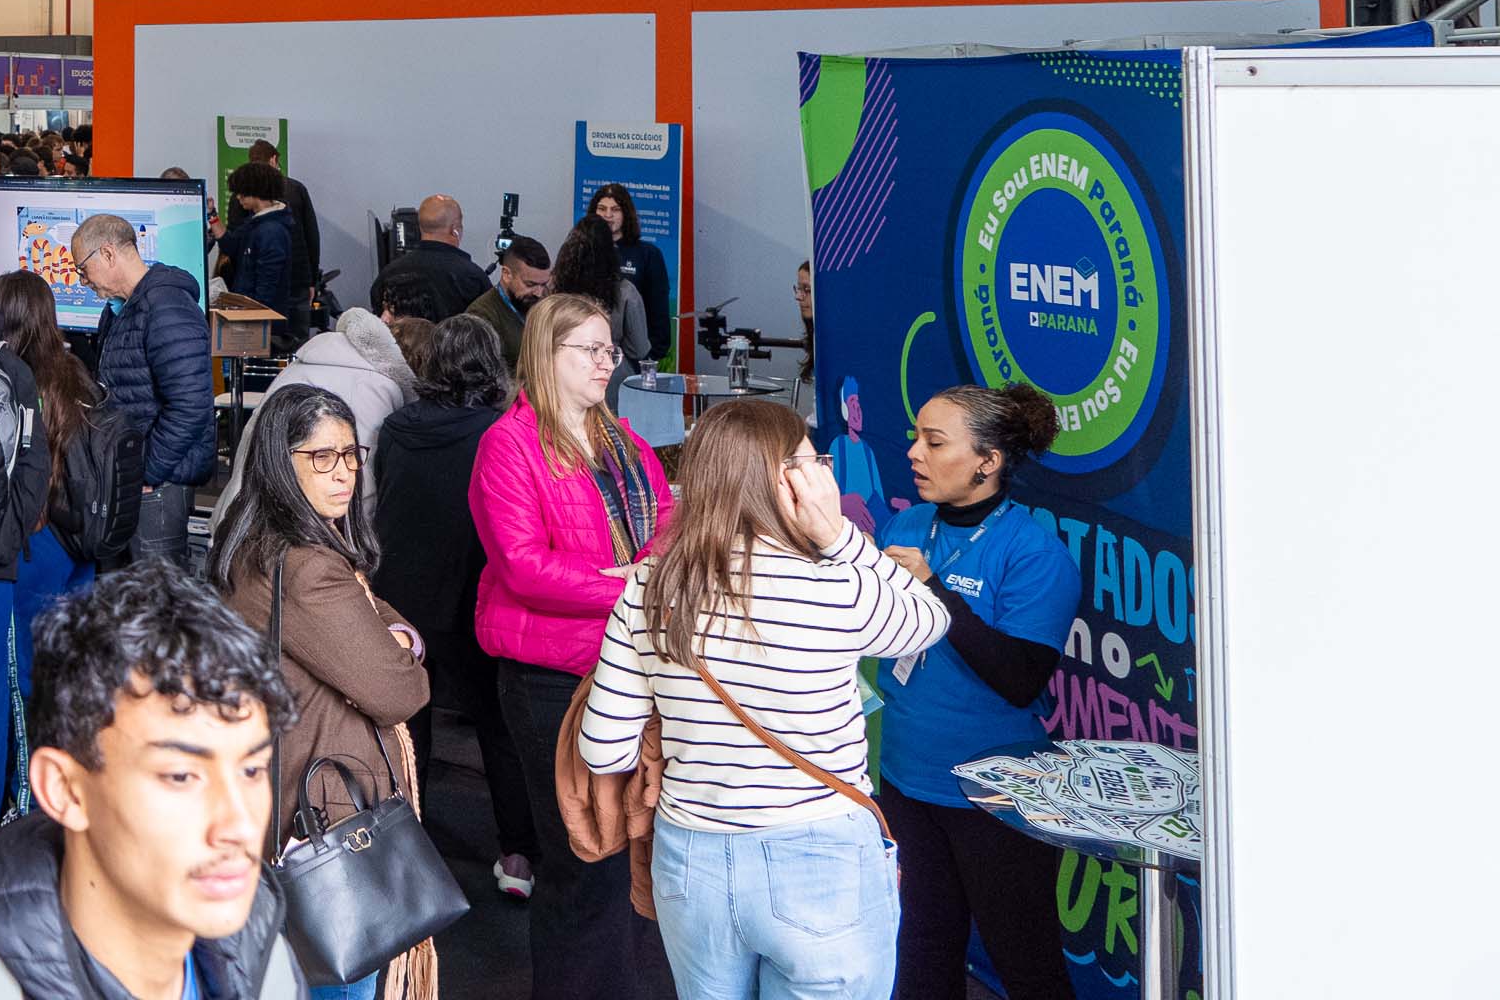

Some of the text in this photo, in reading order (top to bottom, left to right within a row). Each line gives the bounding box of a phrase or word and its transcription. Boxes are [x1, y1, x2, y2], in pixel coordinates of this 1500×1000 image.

[592, 131, 662, 142] DRONES NOS COLÉGIOS
[593, 141, 661, 151] ESTADUAIS AGRÍCOLAS
[1029, 152, 1089, 191] ENEM
[1088, 179, 1144, 308] Paraná
[1010, 262, 1100, 310] ENEM
[974, 285, 1013, 380] araná
[1038, 312, 1099, 336] PARANÁ
[1055, 404, 1082, 432] EN
[946, 573, 984, 592] ENEM
